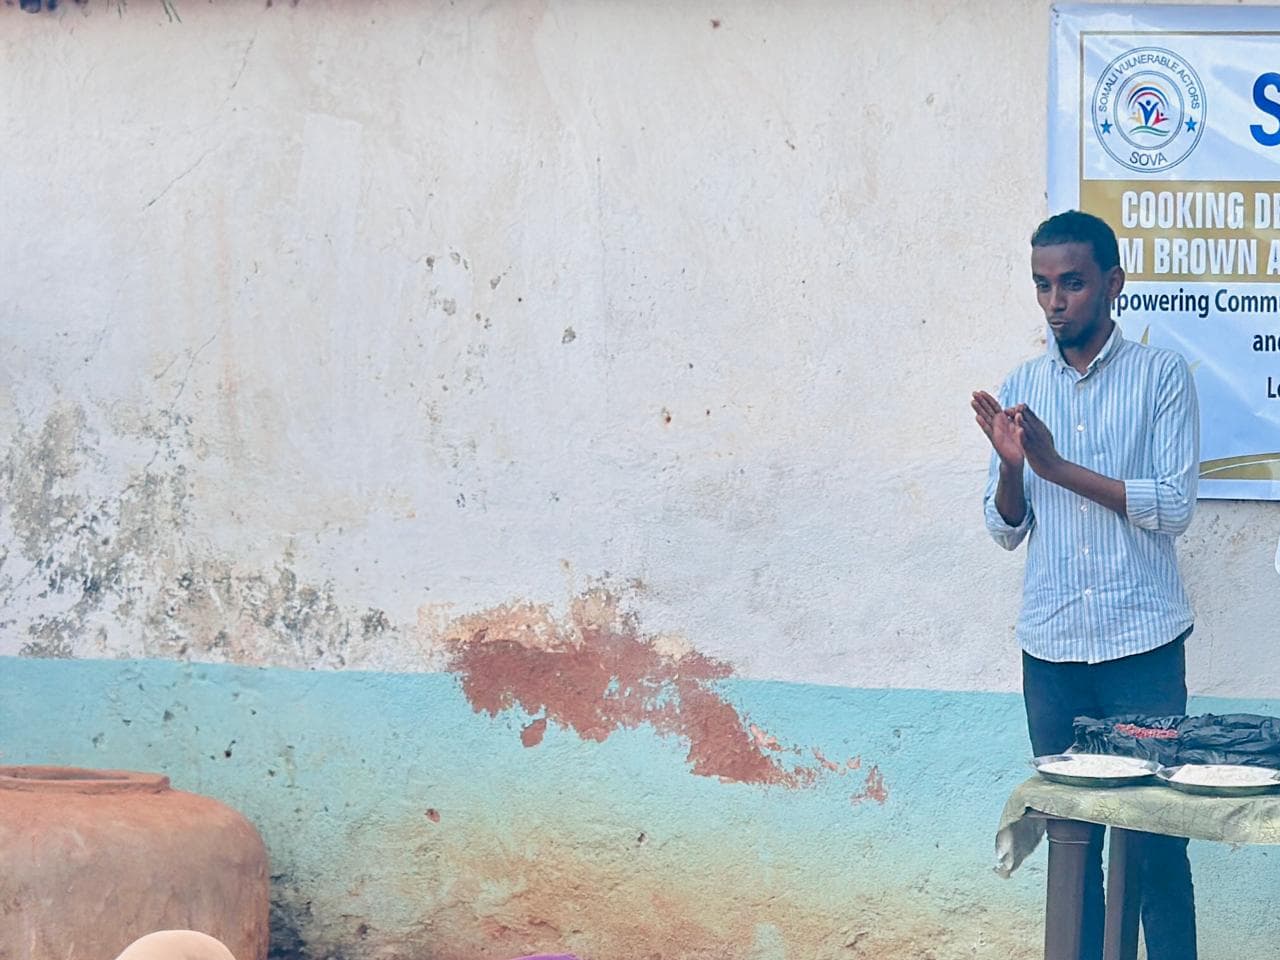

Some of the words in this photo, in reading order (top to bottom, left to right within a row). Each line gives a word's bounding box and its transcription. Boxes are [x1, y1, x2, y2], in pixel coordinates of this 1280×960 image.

[1115, 54, 1180, 75] VULNERABLE
[1176, 69, 1201, 110] ACTORS
[1129, 151, 1168, 166] SOVA
[1121, 191, 1244, 229] COOKING
[1119, 237, 1144, 274] M
[1154, 238, 1257, 276] BROWN
